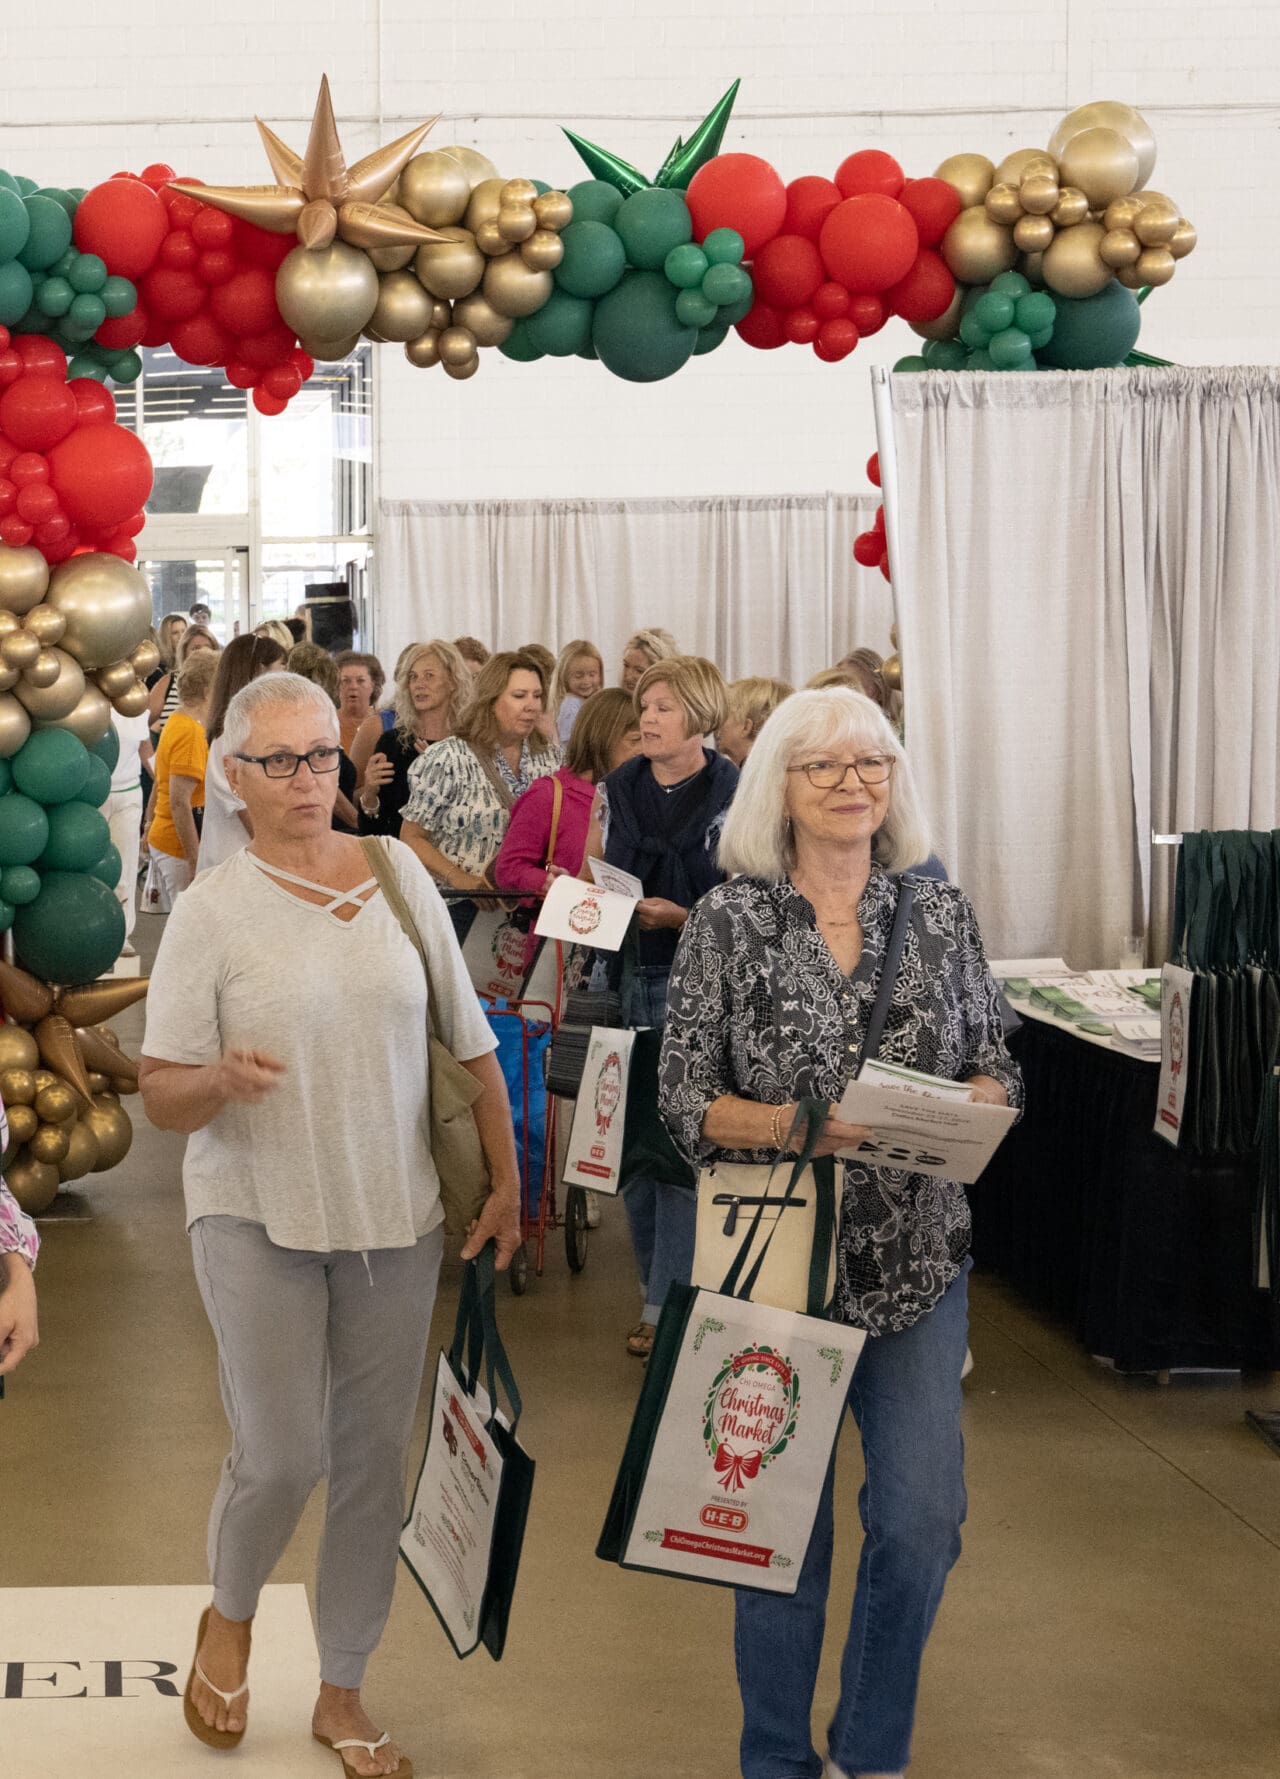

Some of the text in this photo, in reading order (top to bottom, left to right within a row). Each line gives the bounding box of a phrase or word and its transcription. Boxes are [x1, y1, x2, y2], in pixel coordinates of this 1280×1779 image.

[741, 1355, 760, 1364] GIVING
[761, 1355, 774, 1365] SINCE
[739, 1378, 776, 1392] CHI OMEGA
[720, 1387, 786, 1424] Christmas
[719, 1412, 778, 1444] Market
[710, 1495, 739, 1507] PRESENTED
[670, 1535, 766, 1562] ChiOmegaChristmasMarket.org
